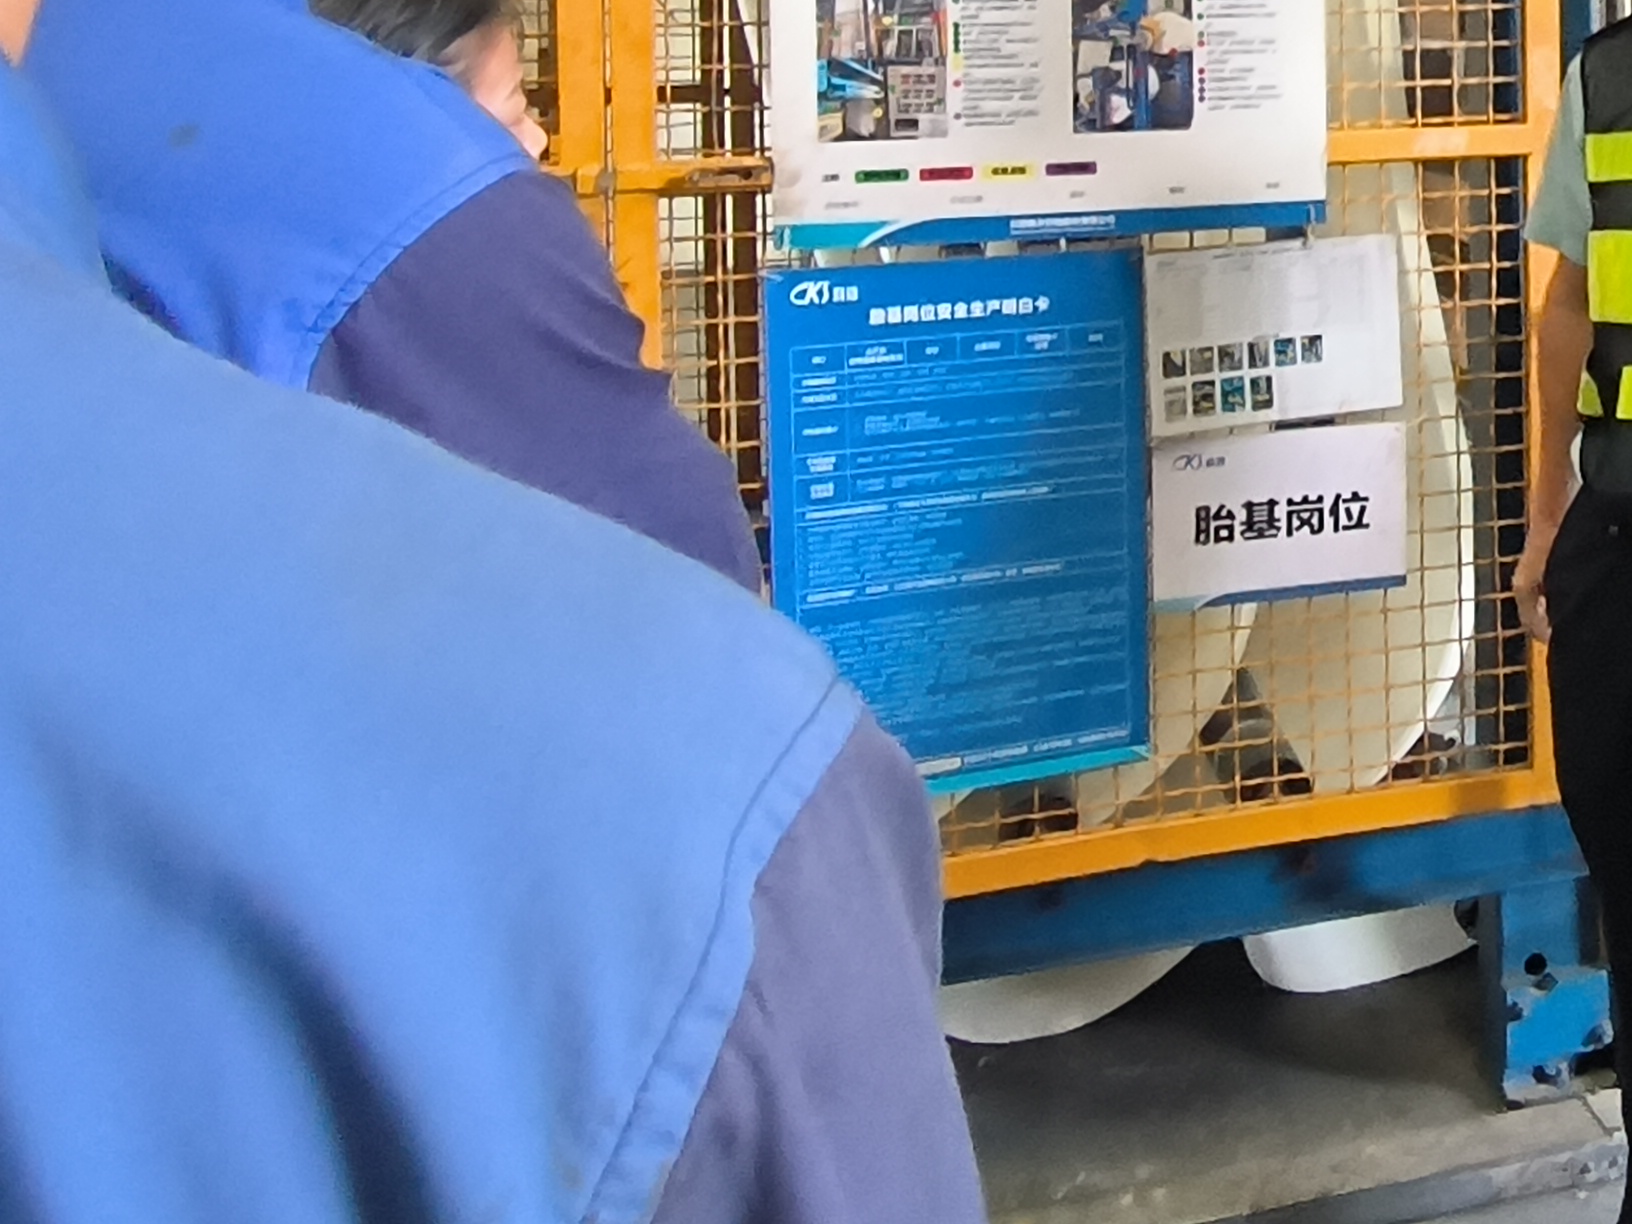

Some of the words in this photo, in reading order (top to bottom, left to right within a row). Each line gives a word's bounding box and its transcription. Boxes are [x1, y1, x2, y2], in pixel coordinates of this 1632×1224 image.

[789, 280, 830, 306] CKS
[1172, 453, 1204, 471] CKS
[1194, 490, 1371, 546] 胎基岗位
